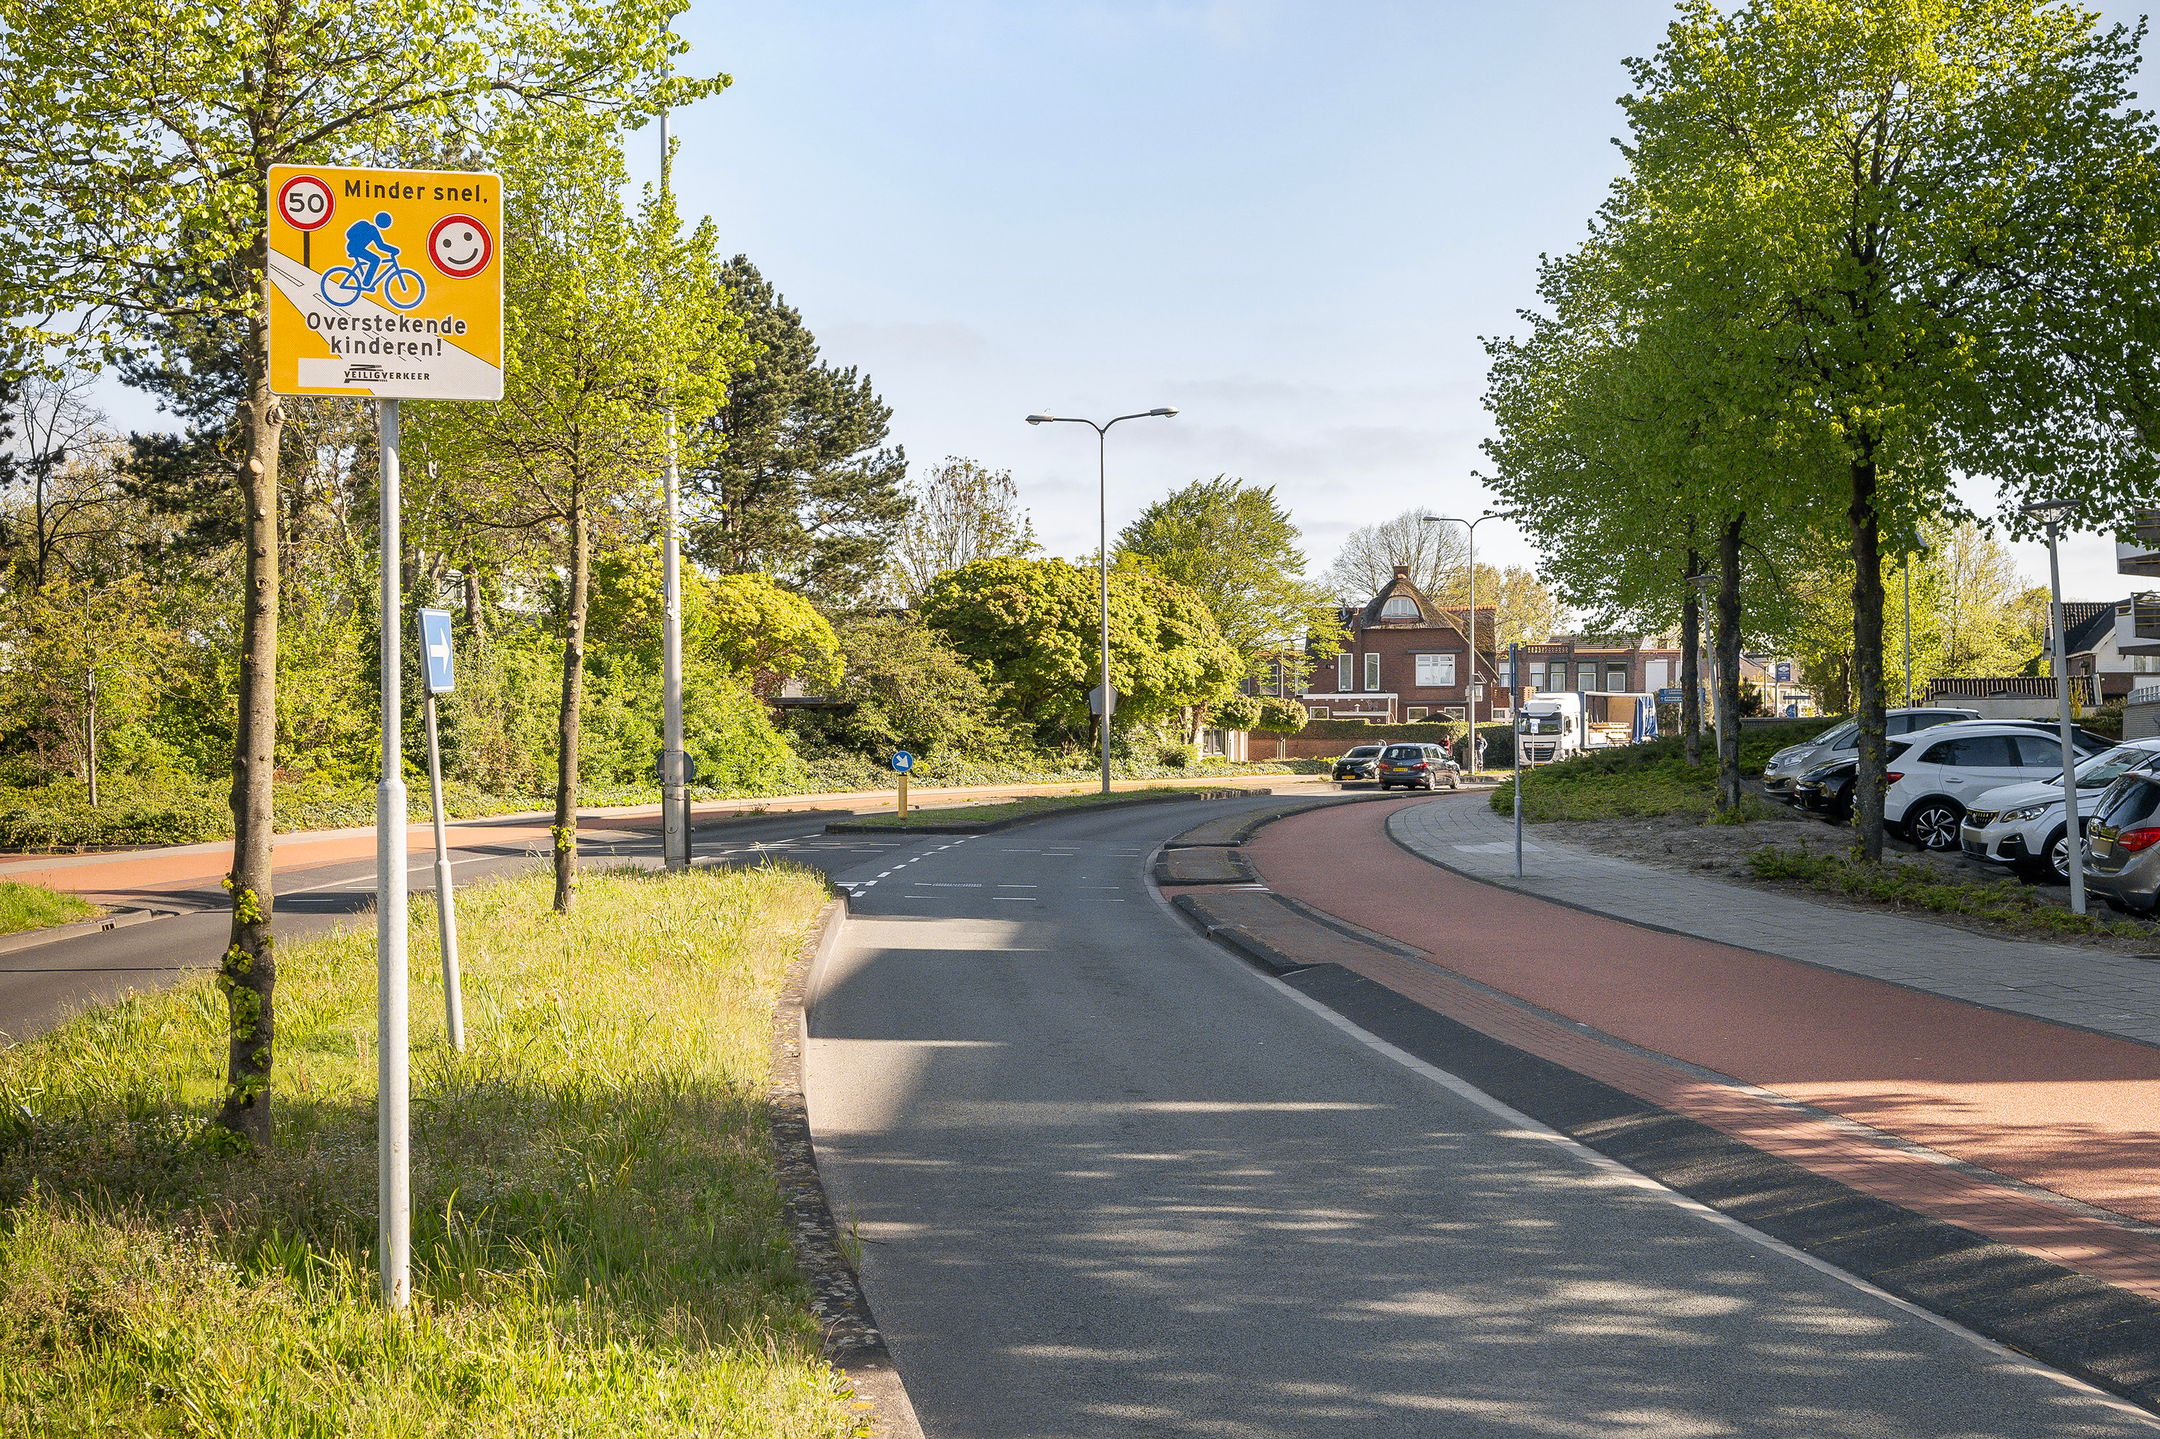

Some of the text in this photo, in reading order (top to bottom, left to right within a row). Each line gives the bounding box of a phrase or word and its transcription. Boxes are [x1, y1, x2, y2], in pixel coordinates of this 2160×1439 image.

[344, 179, 488, 204] Minder snel,
[288, 192, 325, 214] 50
[306, 312, 467, 334] Overstekende
[331, 335, 443, 356] kinderen!
